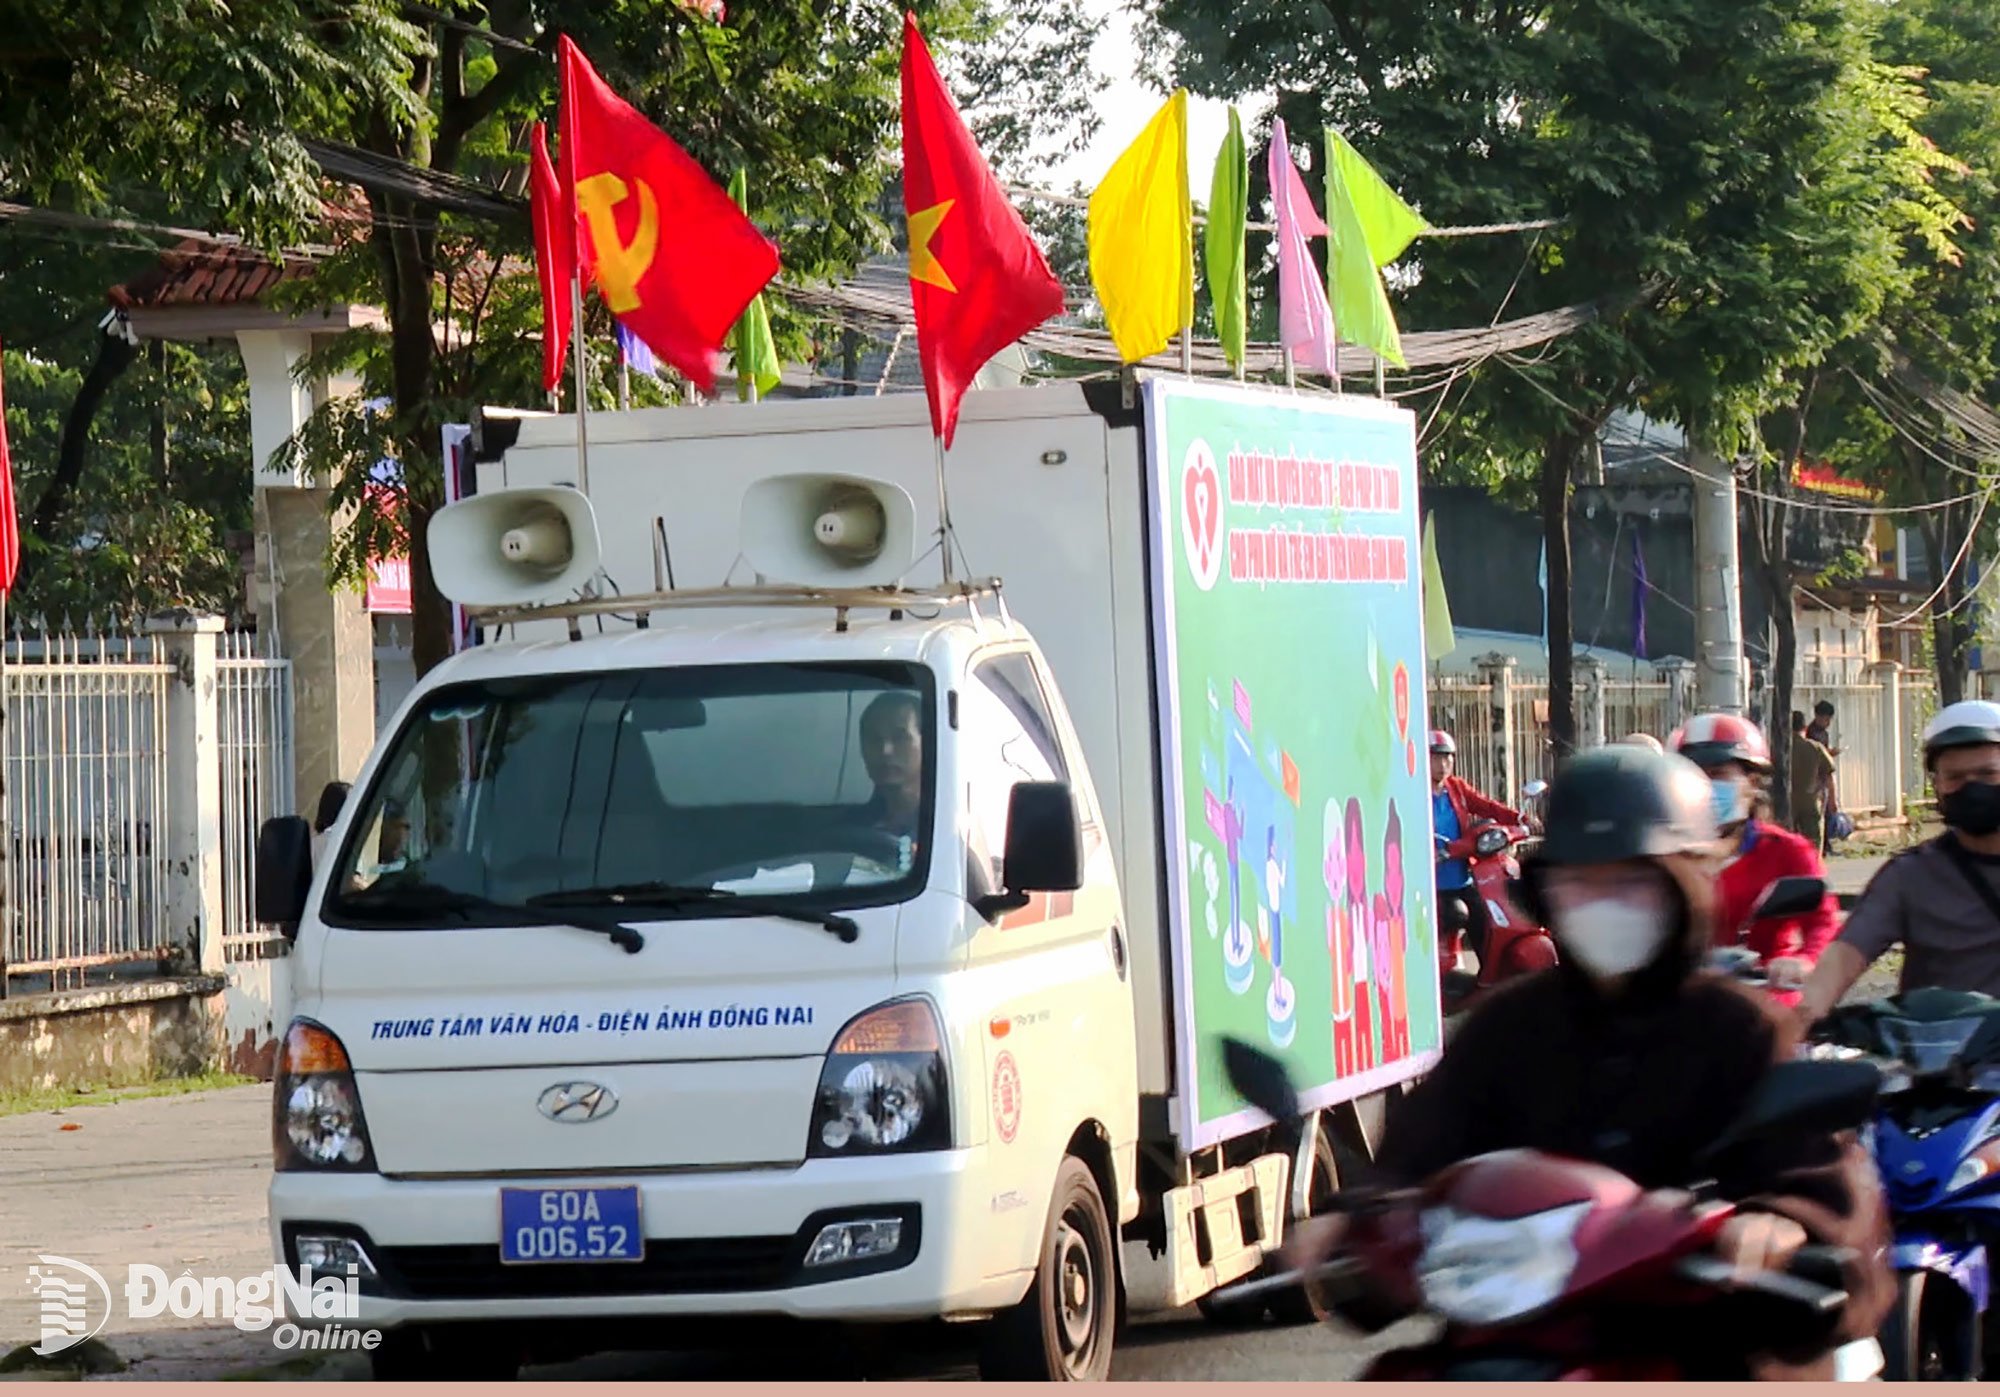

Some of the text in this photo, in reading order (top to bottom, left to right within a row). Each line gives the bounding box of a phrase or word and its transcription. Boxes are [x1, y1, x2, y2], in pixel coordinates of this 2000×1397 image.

[371, 1017, 435, 1040] TRUNG
[490, 1011, 533, 1034] VĂN
[537, 1009, 580, 1034] HÓA
[598, 1008, 650, 1037] ĐIỆN
[655, 1004, 703, 1030] ẢNH
[708, 1002, 769, 1029] ĐỒNG
[774, 1004, 814, 1027] NAI
[540, 1190, 602, 1223] 60A
[516, 1224, 628, 1258] 006.52
